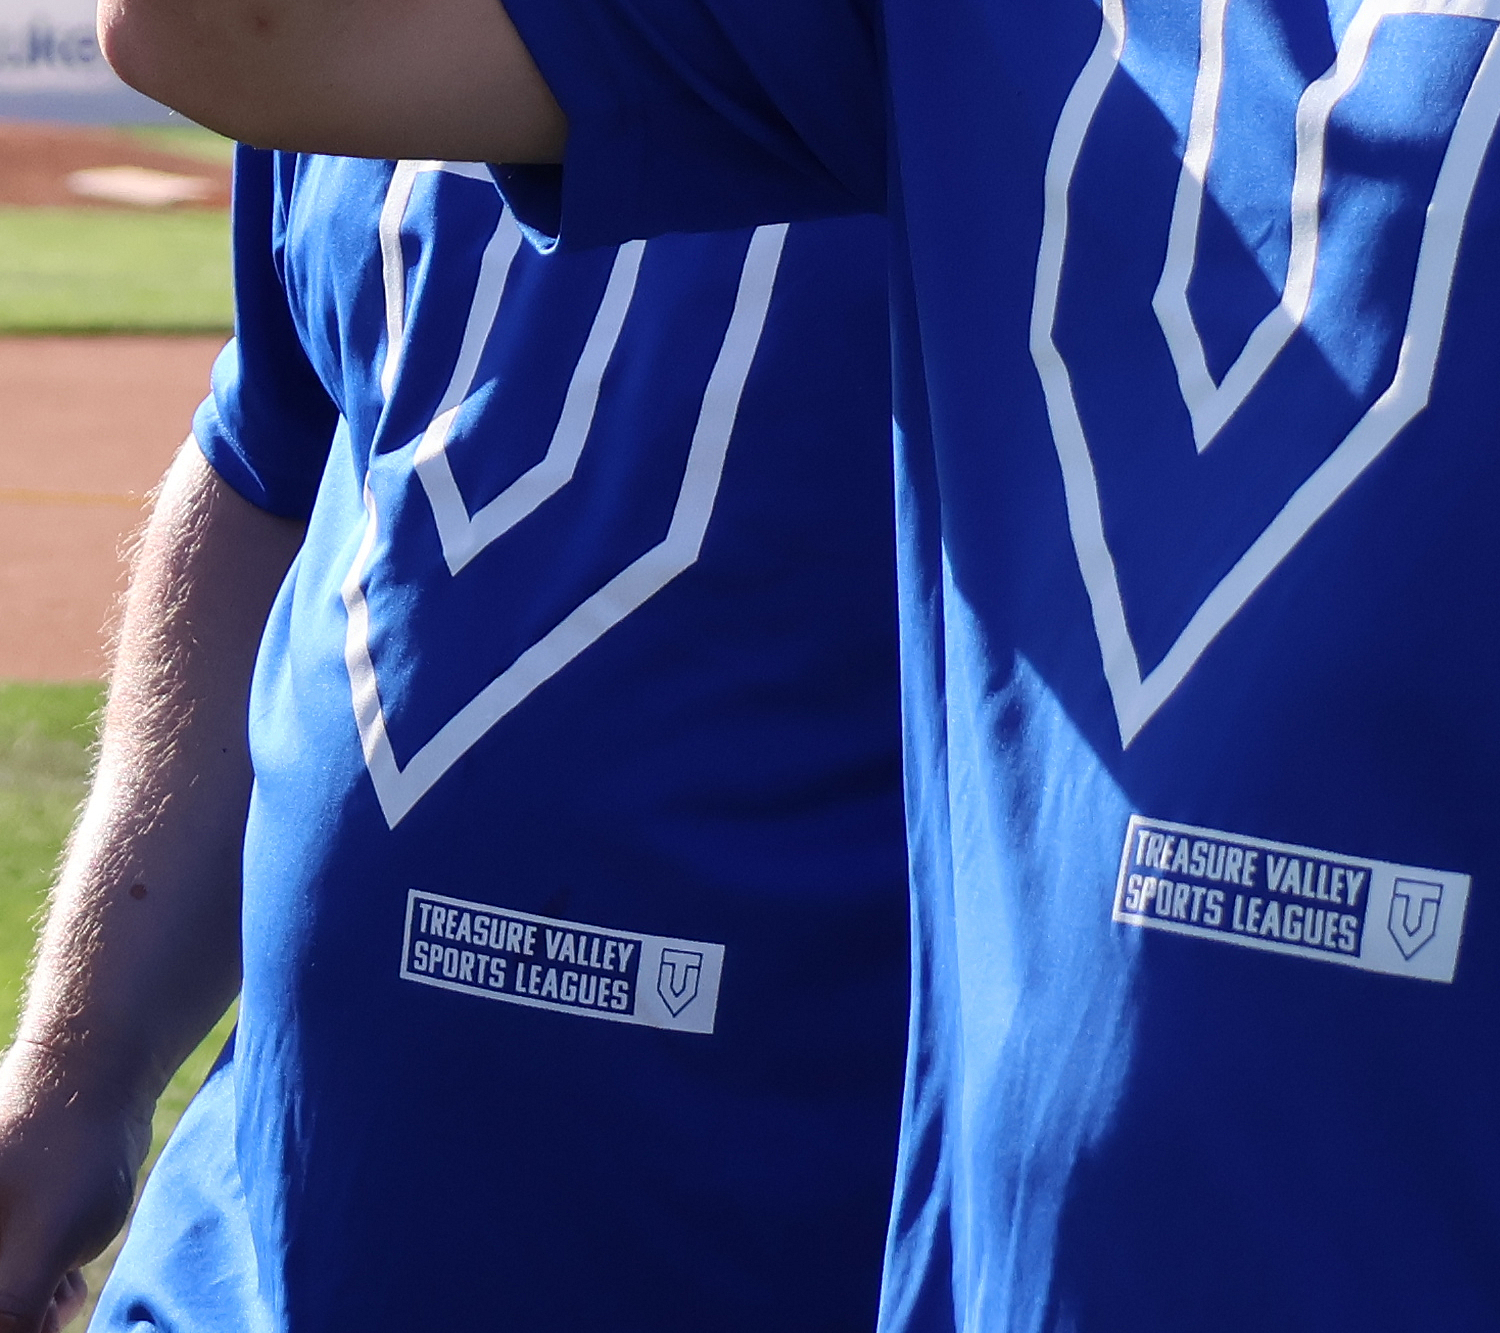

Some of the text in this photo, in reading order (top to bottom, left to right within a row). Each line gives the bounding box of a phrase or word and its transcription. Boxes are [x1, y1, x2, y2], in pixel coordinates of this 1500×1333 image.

[1134, 829, 1366, 907] TREASURE VALLEY
[418, 902, 635, 973] TREASURE VALLEY
[1125, 873, 1358, 951] SPORTS LEAGUES
[413, 940, 629, 1011] SPORTS LEAGUES
